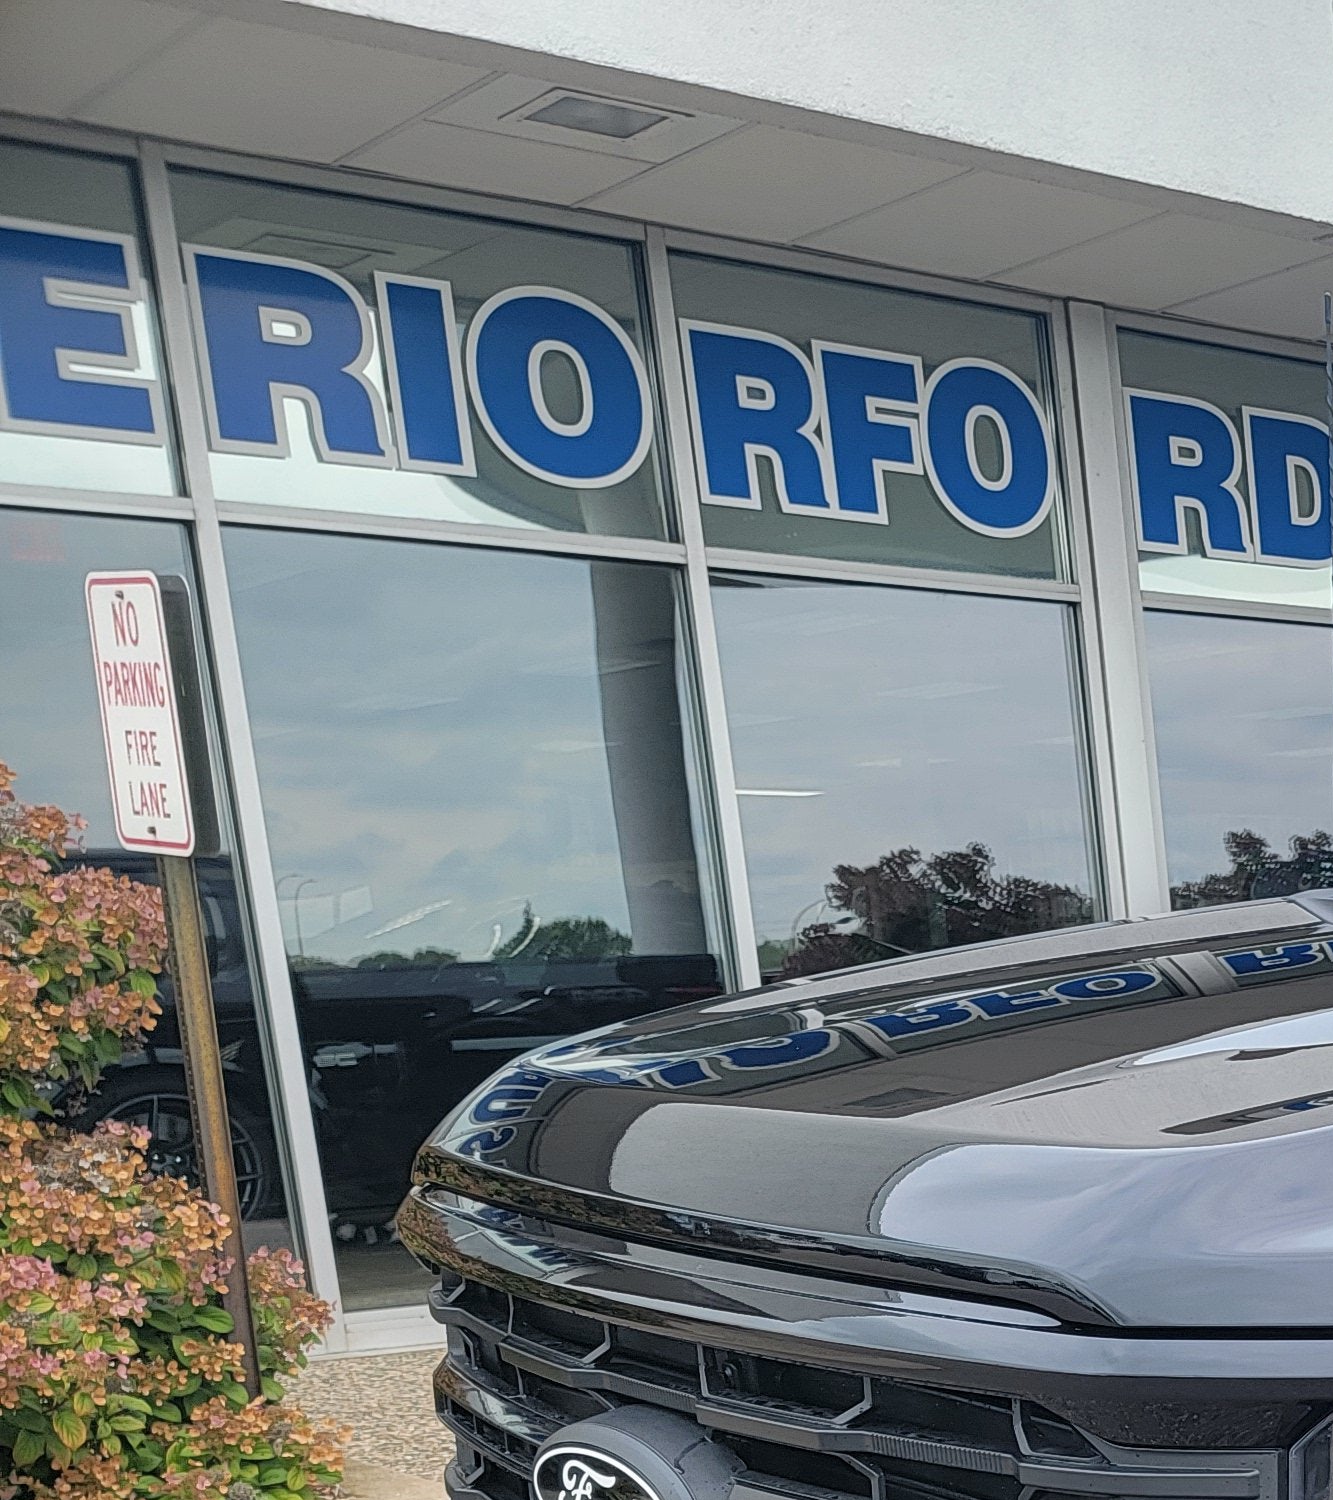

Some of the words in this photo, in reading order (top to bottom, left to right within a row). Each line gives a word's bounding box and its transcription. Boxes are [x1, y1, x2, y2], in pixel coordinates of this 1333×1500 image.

[111, 600, 140, 647] NO
[103, 660, 166, 709] PARKING
[124, 729, 162, 767] FIRE
[127, 780, 172, 819] LANE
